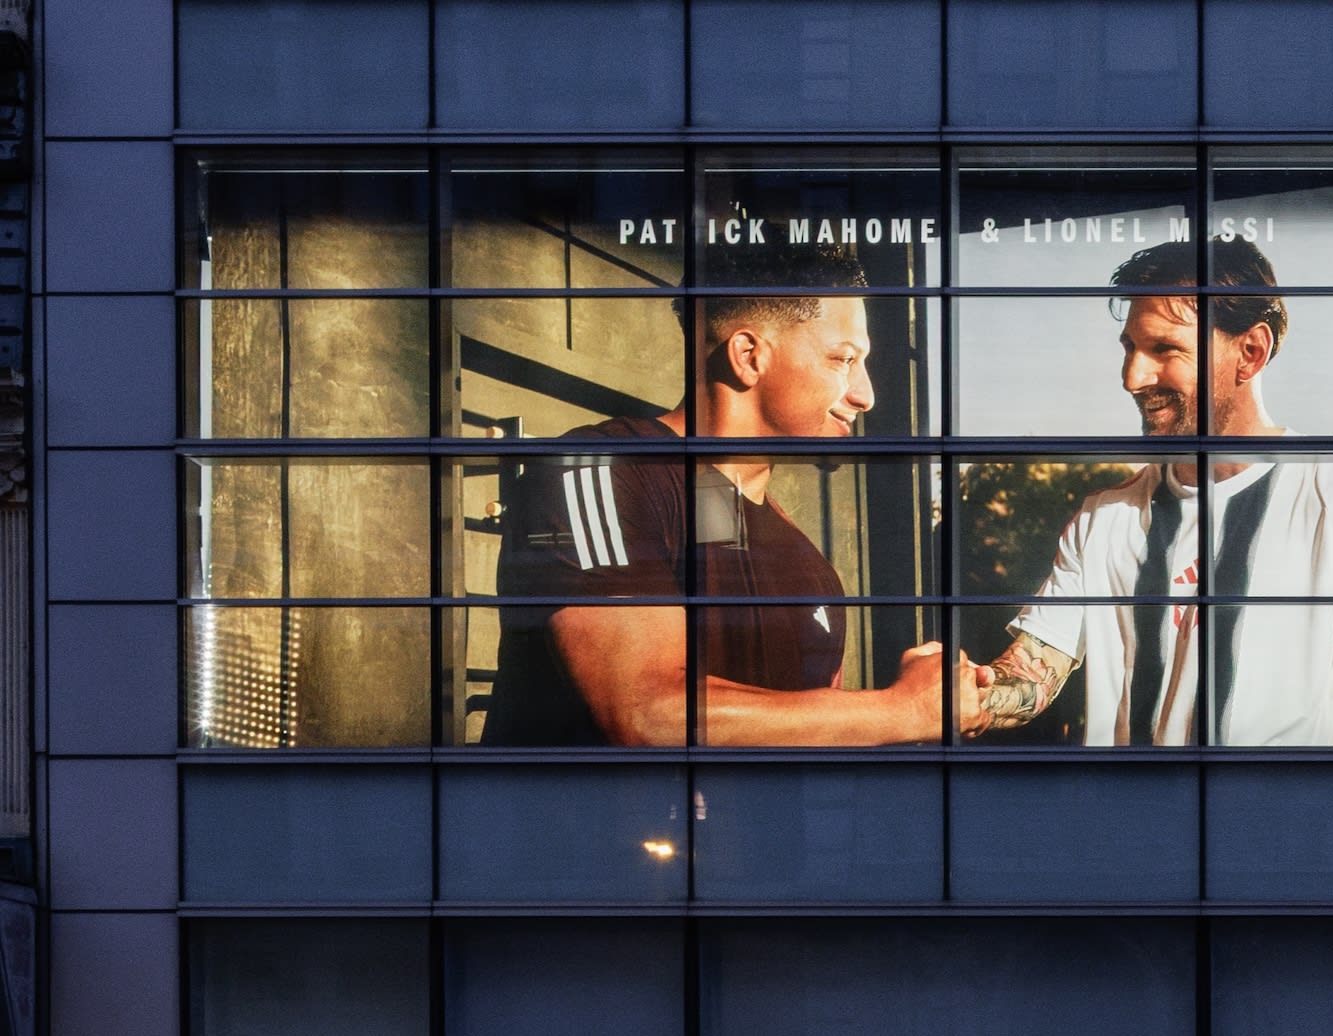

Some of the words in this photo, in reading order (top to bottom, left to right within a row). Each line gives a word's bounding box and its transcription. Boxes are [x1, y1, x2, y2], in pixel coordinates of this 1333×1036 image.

[619, 218, 766, 244] PATICK
[788, 218, 937, 244] MAHOME
[980, 217, 1000, 244] &
[1023, 217, 1146, 243] LIONEL
[1168, 217, 1275, 243] MSSI
